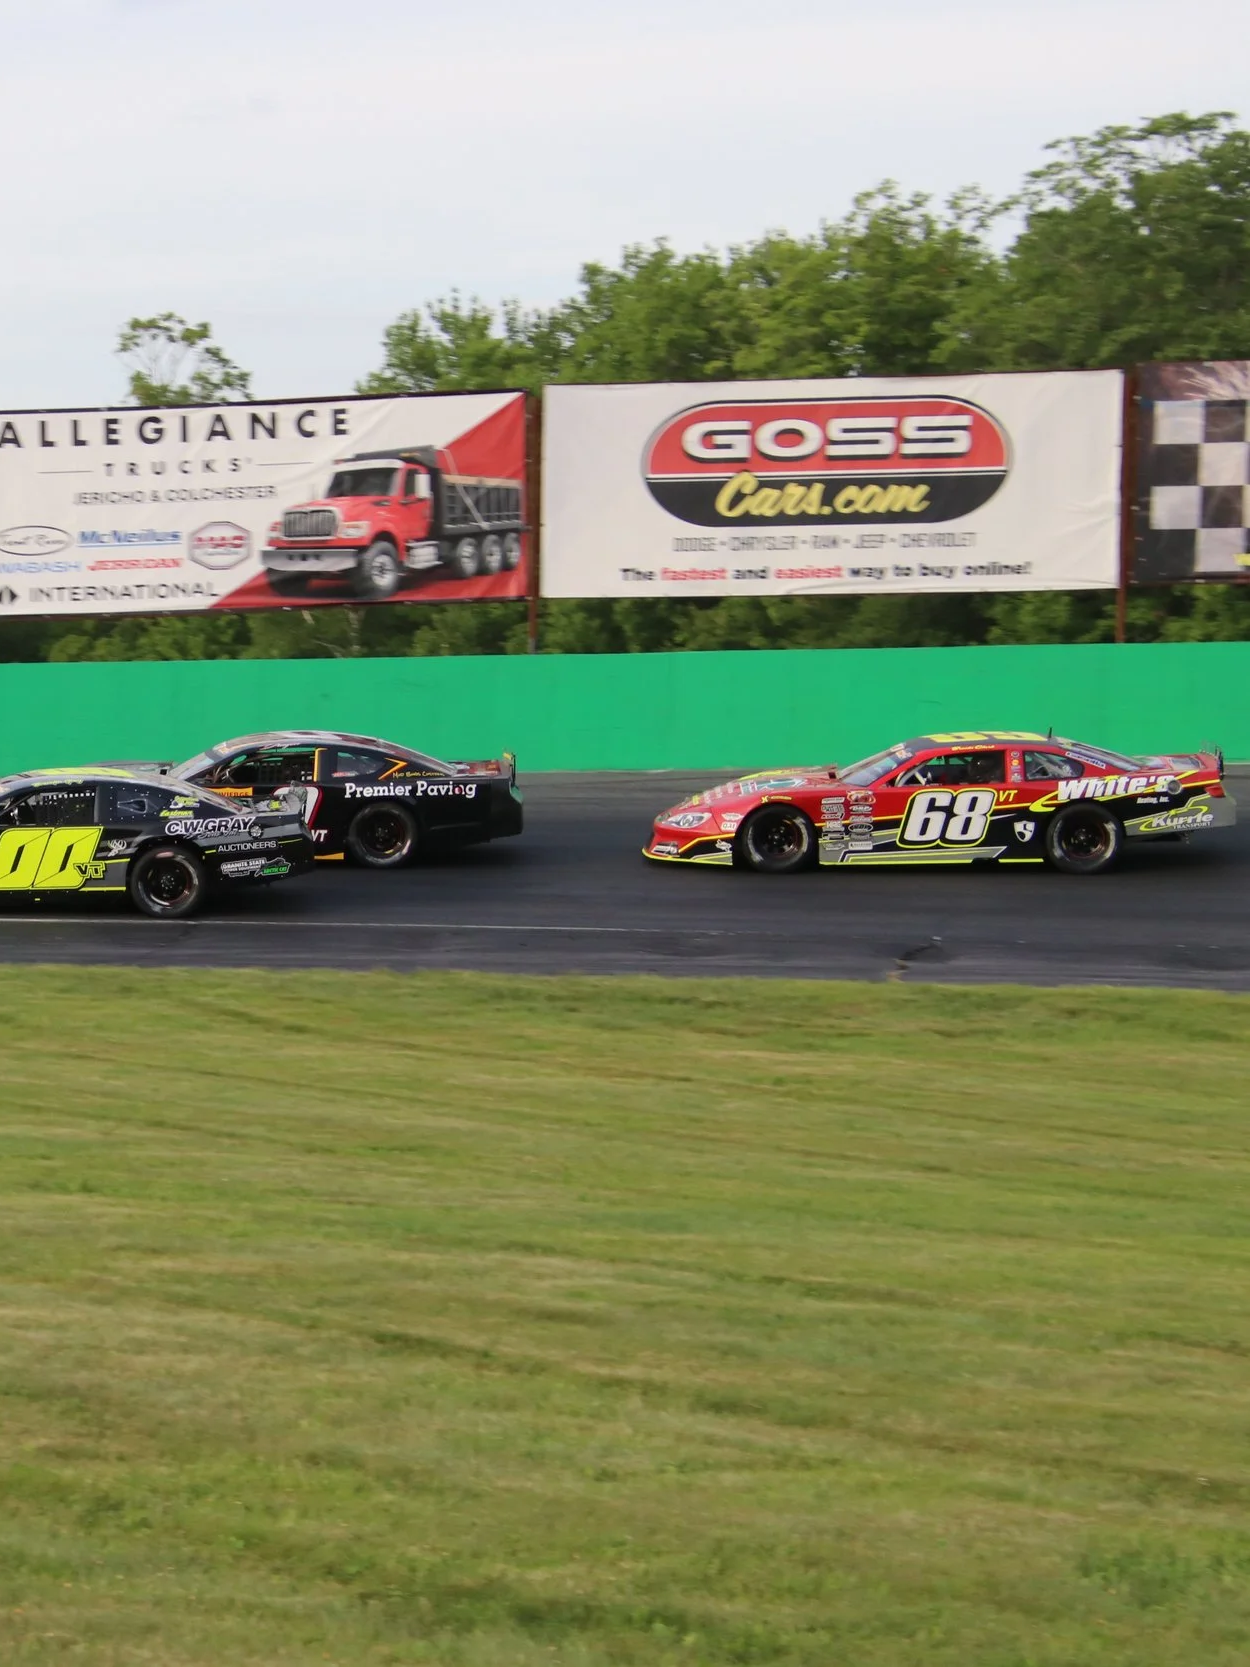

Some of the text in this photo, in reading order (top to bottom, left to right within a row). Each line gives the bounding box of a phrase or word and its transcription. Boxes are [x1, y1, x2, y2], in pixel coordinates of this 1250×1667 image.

[681, 413, 974, 461] GOSS
[103, 458, 243, 477] TRUCKS
[74, 485, 278, 505] JERICHO & COLCHESTER
[714, 470, 931, 518] Cars.com
[672, 537, 718, 551] DODGE
[853, 533, 886, 549] JEEP
[619, 561, 1033, 581] The fastest and easiest way to buy online!
[29, 582, 221, 603] INTERNATIONAL
[344, 780, 477, 798] Premier Paving
[998, 789, 1018, 802] VT
[1057, 775, 1176, 801] White's
[897, 788, 998, 847] 68
[1173, 822, 1212, 830] TRANSPORT
[218, 841, 277, 852] AUCTIONEERS
[73, 861, 105, 880] VT
[222, 861, 248, 869] GRANITE
